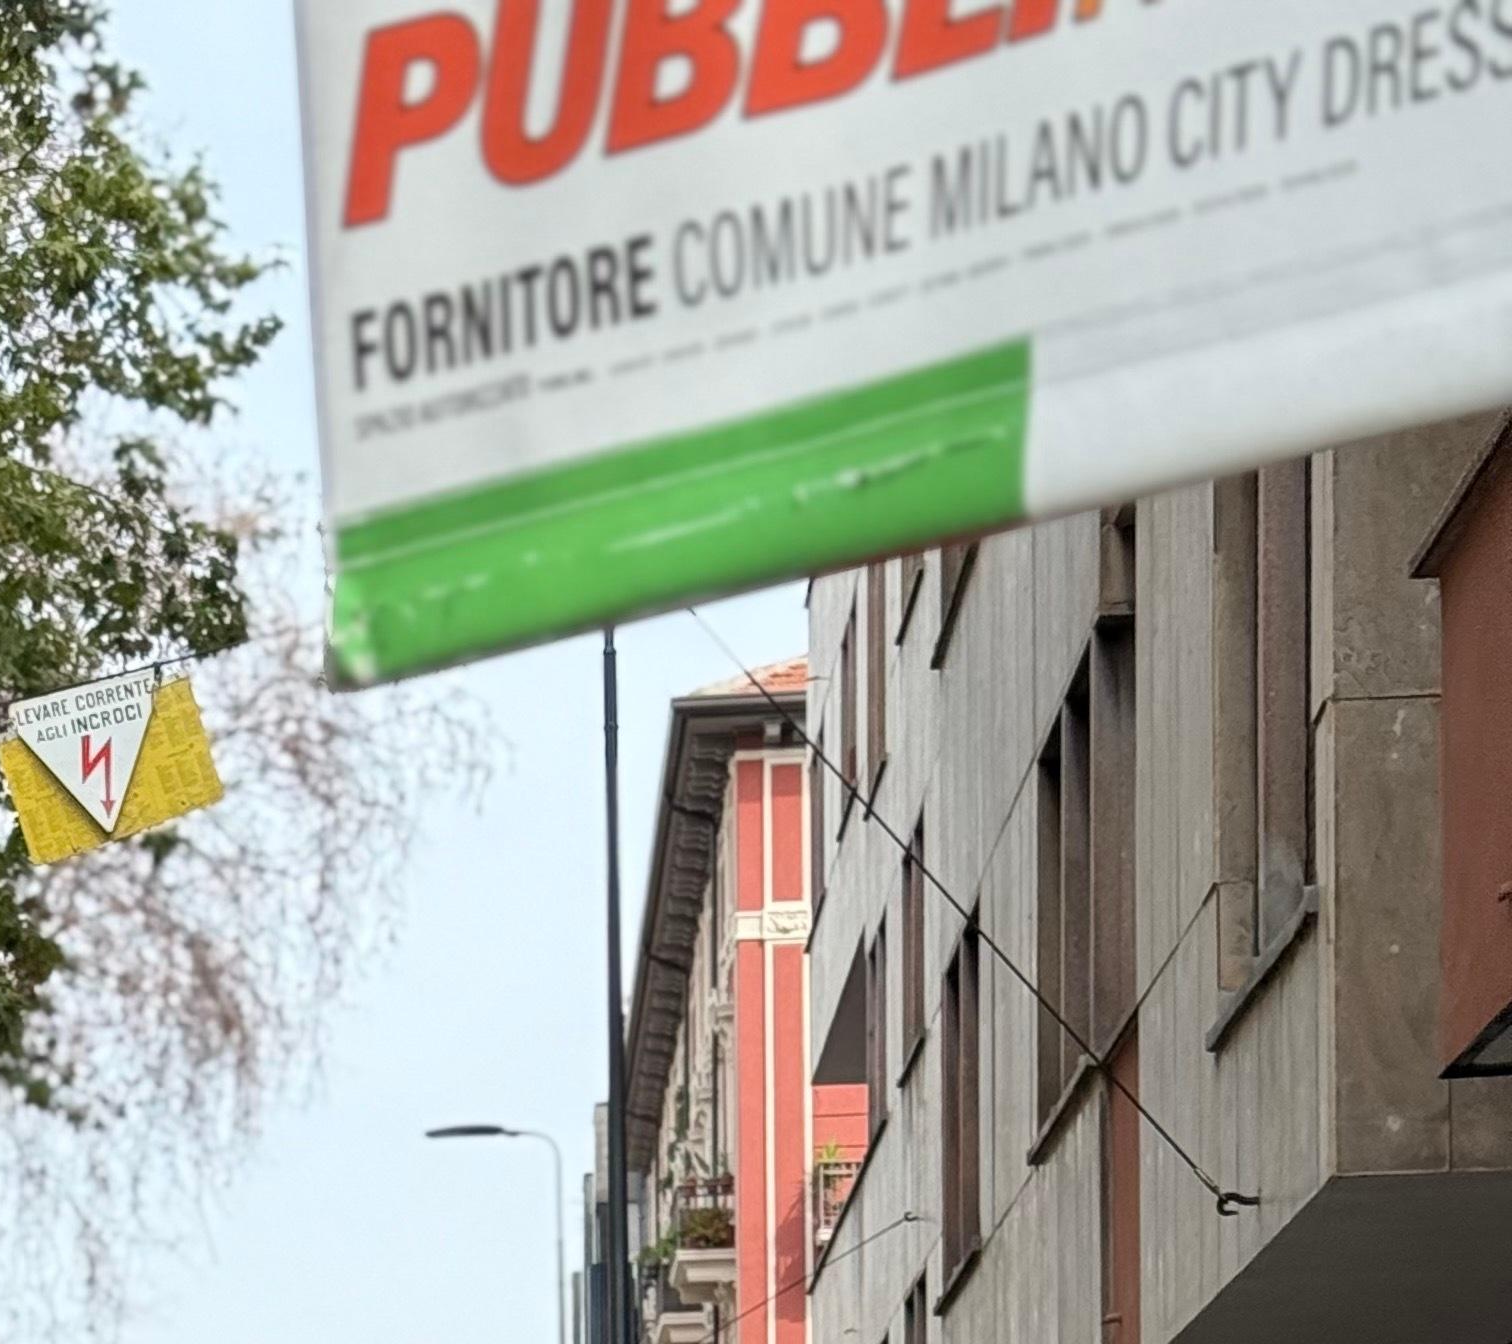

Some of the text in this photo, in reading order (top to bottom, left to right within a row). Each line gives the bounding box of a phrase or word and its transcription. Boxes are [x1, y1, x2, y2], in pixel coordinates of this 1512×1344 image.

[350, 232, 659, 392] FORNITORE
[671, 163, 915, 309] COMUNE
[929, 92, 1149, 240] MILANO
[1168, 46, 1302, 170] CITY
[15, 679, 152, 726] LEVARE CORRENTE
[37, 703, 143, 744] AGLI INCROCI
